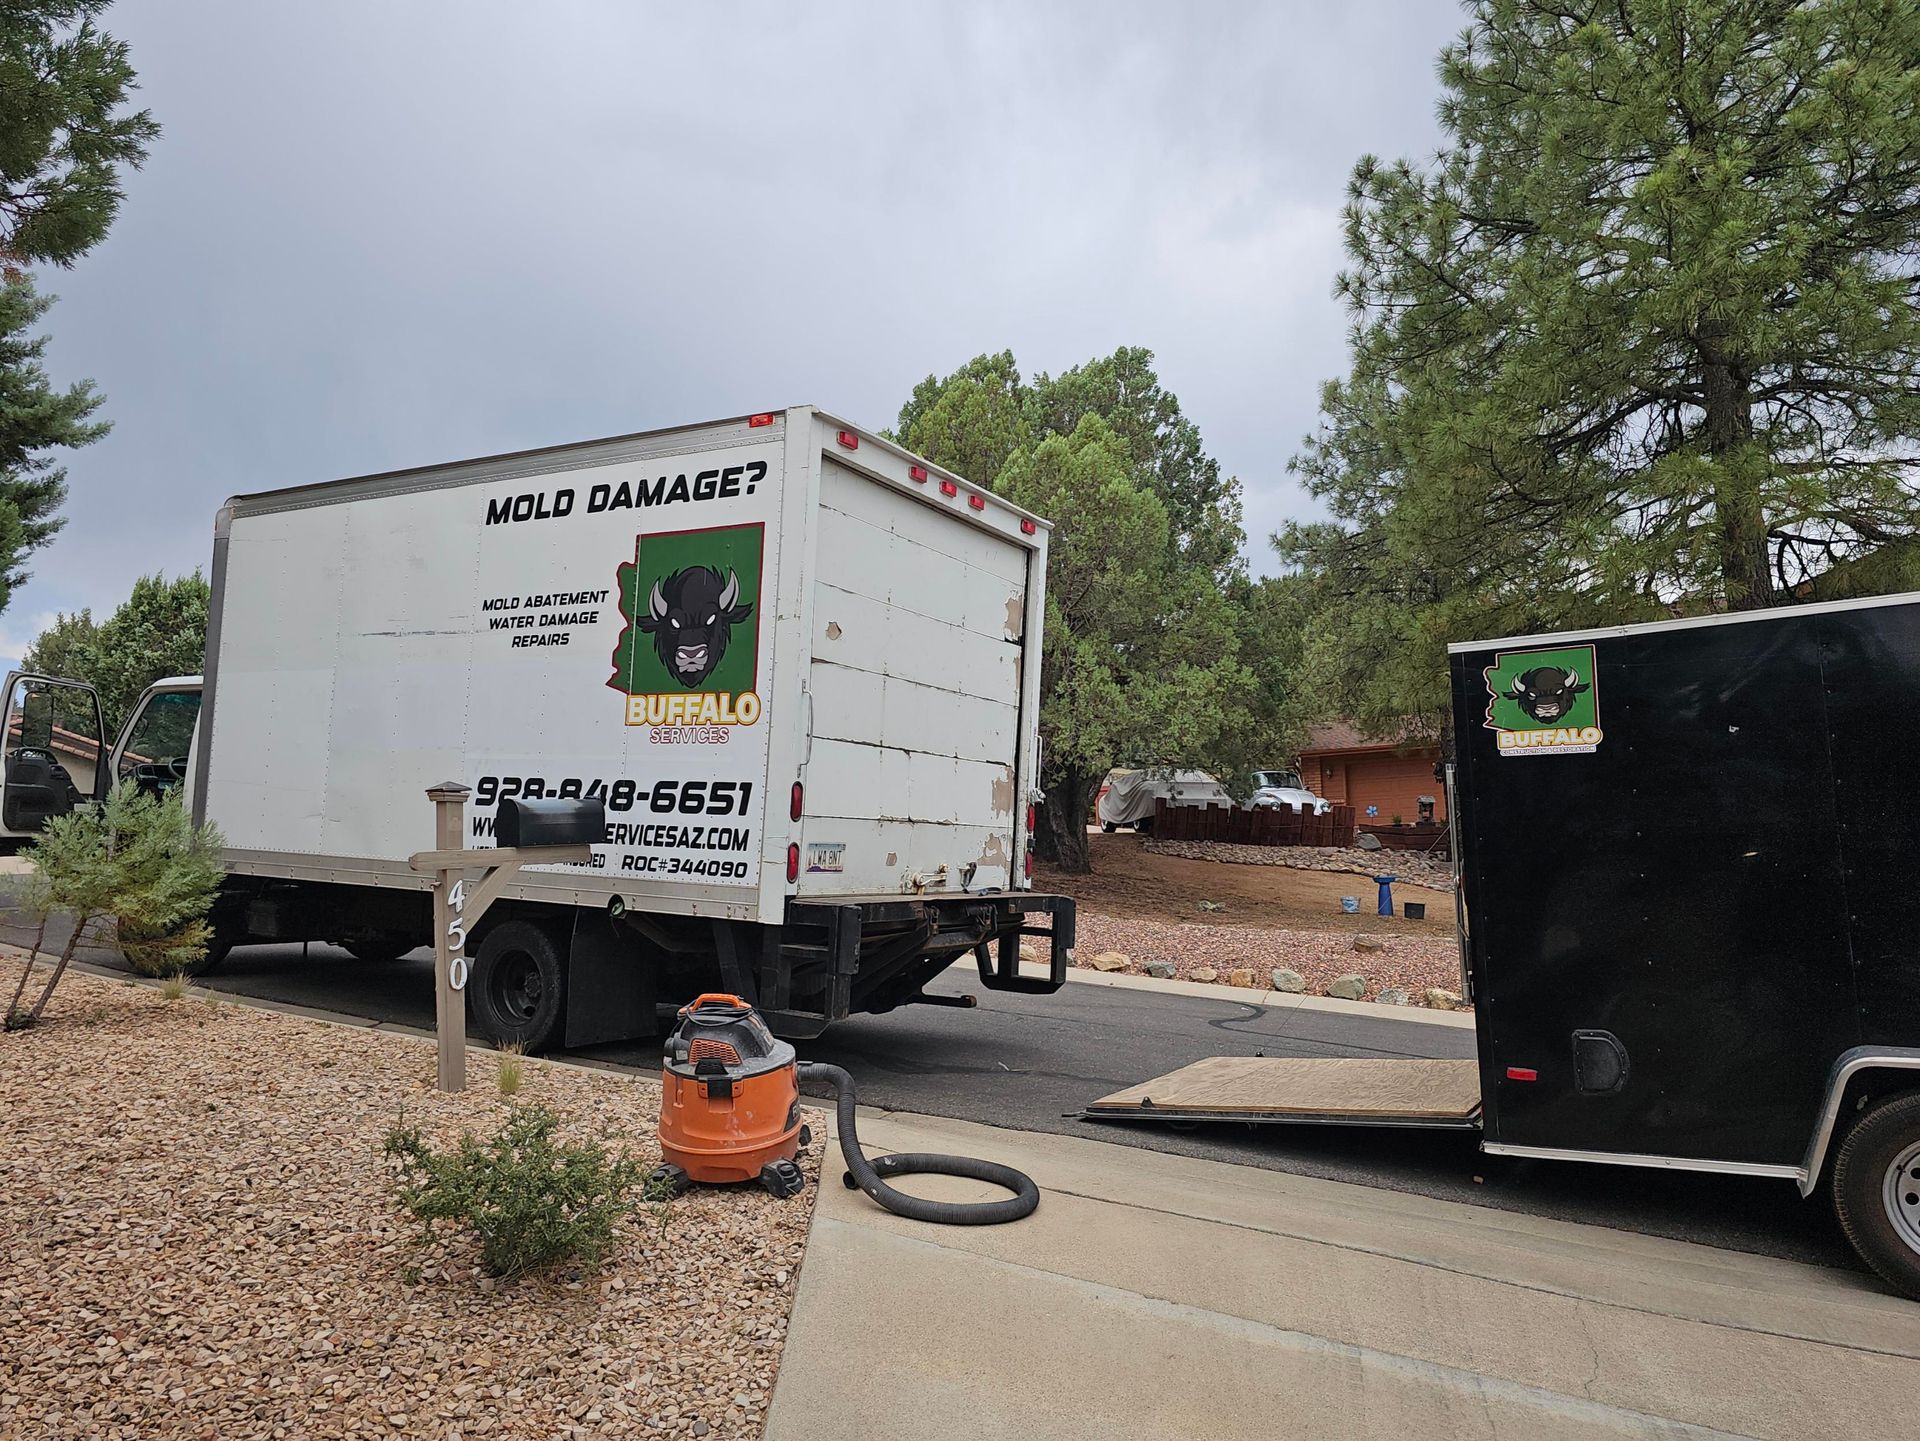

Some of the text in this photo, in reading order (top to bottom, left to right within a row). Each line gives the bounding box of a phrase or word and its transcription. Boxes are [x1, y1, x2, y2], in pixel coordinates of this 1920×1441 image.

[486, 461, 768, 525] MOLD DAMAGE?
[482, 590, 609, 611] MOLD ABATEMENT
[489, 611, 599, 630] WATER DAMAGE
[512, 633, 570, 648] REPAIRS
[625, 691, 761, 726] BUFFALO
[650, 727, 730, 744] SERVICES
[1499, 727, 1601, 748] BUFFALO
[475, 776, 753, 816] 928-848-6651
[621, 855, 748, 878] ROC#344090
[447, 879, 469, 990] 450
